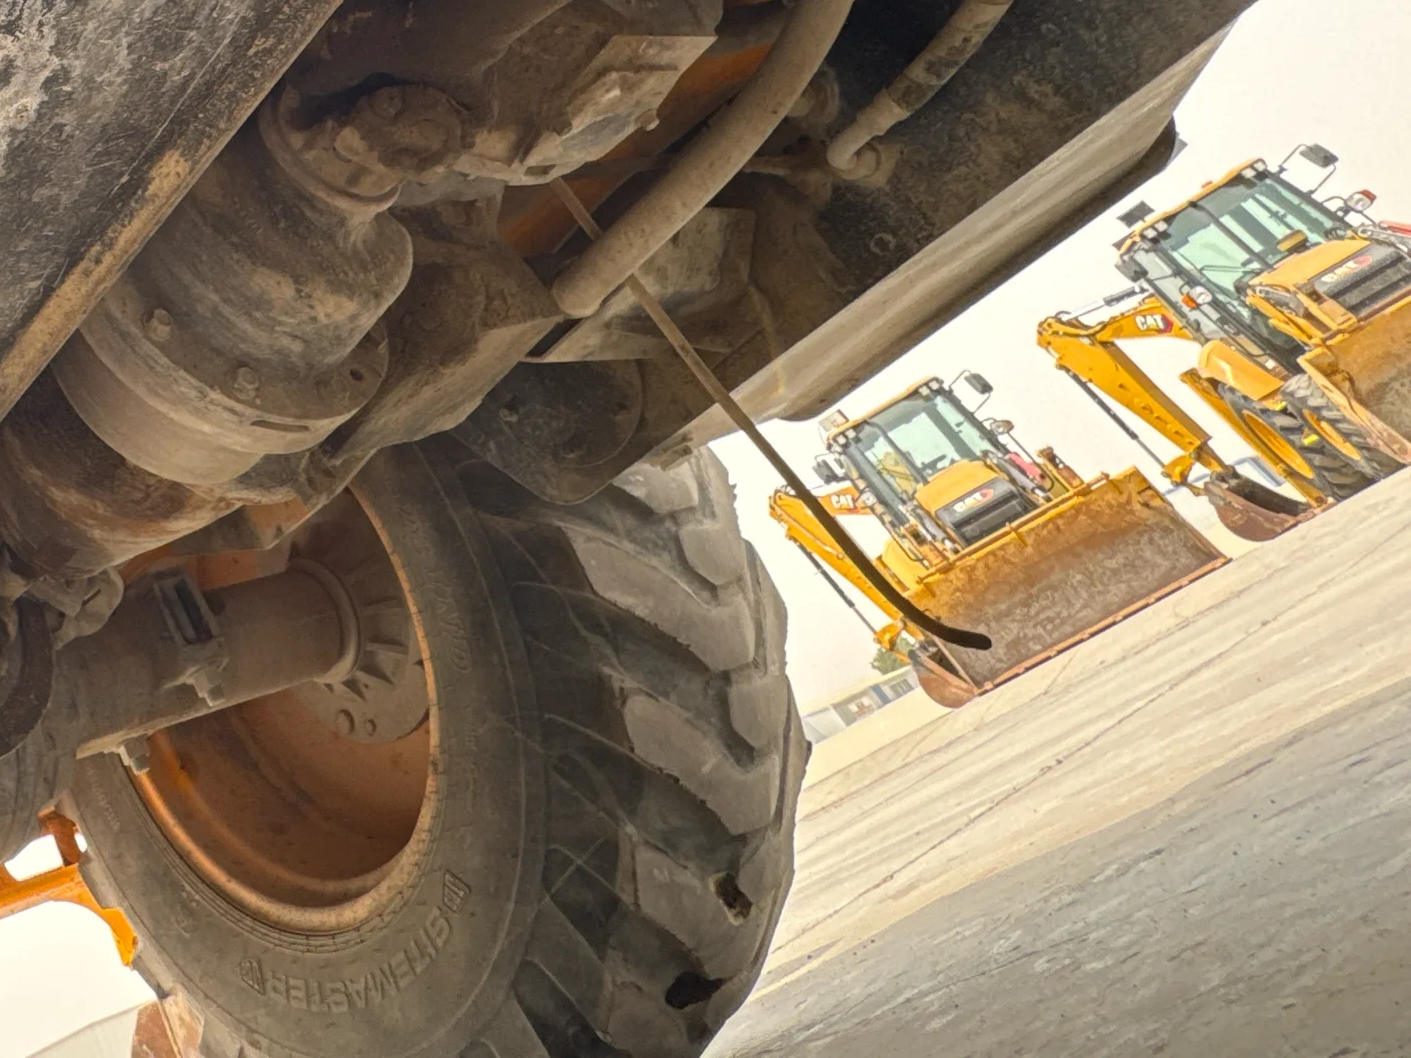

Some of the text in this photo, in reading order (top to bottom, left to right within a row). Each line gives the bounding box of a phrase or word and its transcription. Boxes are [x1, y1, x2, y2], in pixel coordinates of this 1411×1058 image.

[1135, 313, 1165, 331] CAT
[830, 494, 854, 509] CAT
[265, 905, 452, 1013] SITEMASTER
